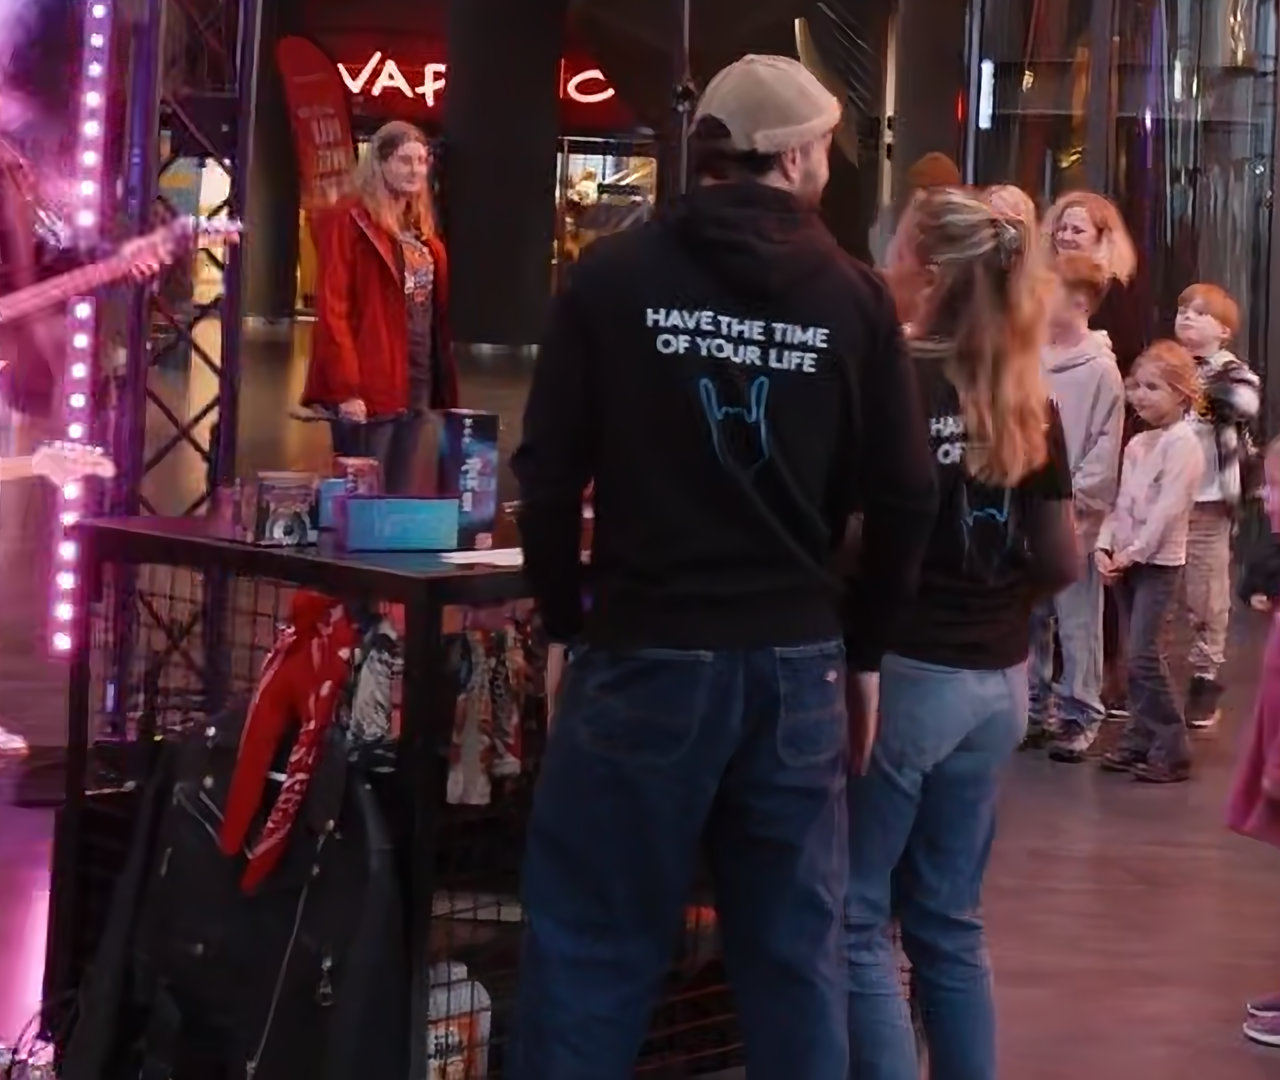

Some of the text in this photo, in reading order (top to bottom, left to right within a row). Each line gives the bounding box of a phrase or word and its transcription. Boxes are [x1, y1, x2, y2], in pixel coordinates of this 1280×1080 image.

[646, 308, 830, 348] HAVE THE TIME
[656, 333, 818, 373] OF YOUR LIFE
